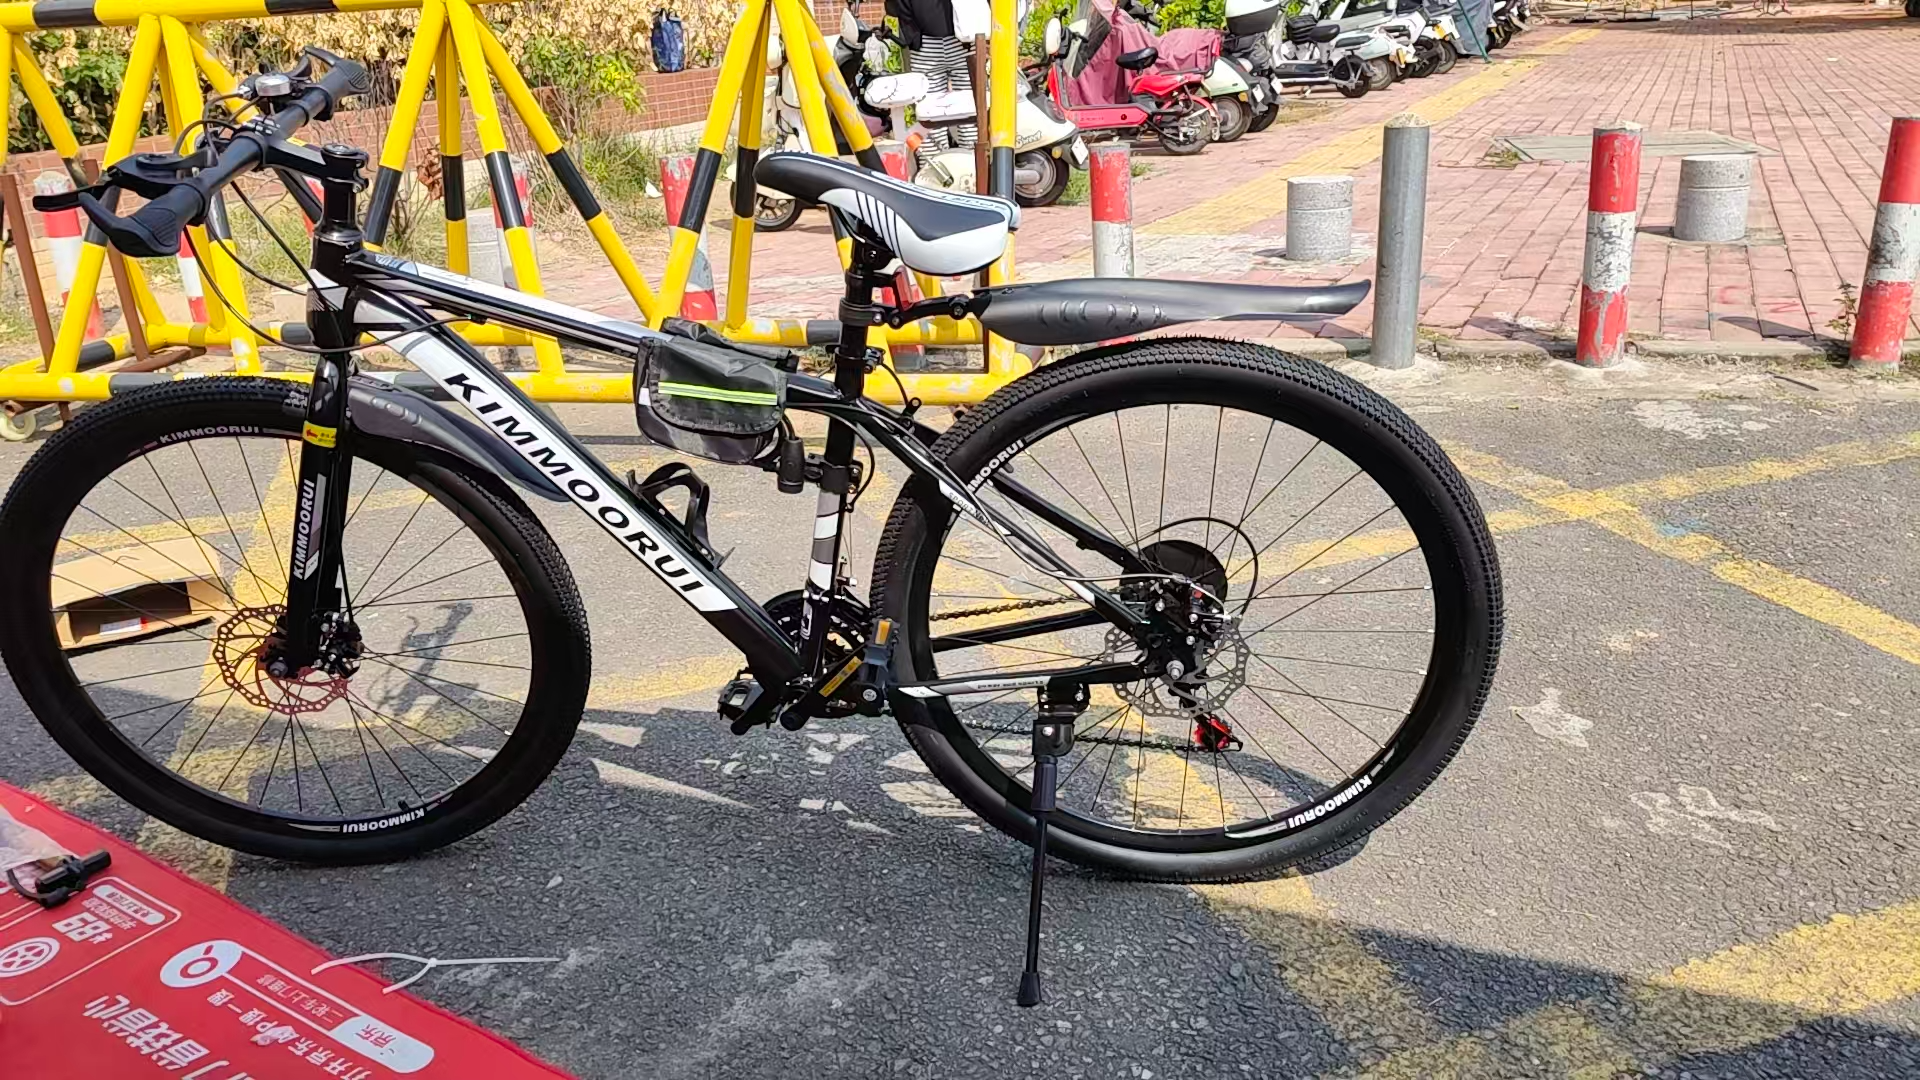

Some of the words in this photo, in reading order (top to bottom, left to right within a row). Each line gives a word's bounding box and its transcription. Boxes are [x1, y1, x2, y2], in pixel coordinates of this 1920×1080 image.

[160, 426, 259, 443] KIMMOORUI
[443, 373, 704, 592] KIMMOORUI
[967, 440, 1024, 492] MOORUI
[293, 479, 315, 580] KIMMOORUI
[342, 808, 425, 833] KIMMOORUI
[1287, 774, 1373, 828] KIMMOORUI
[354, 1023, 397, 1048] 京东
